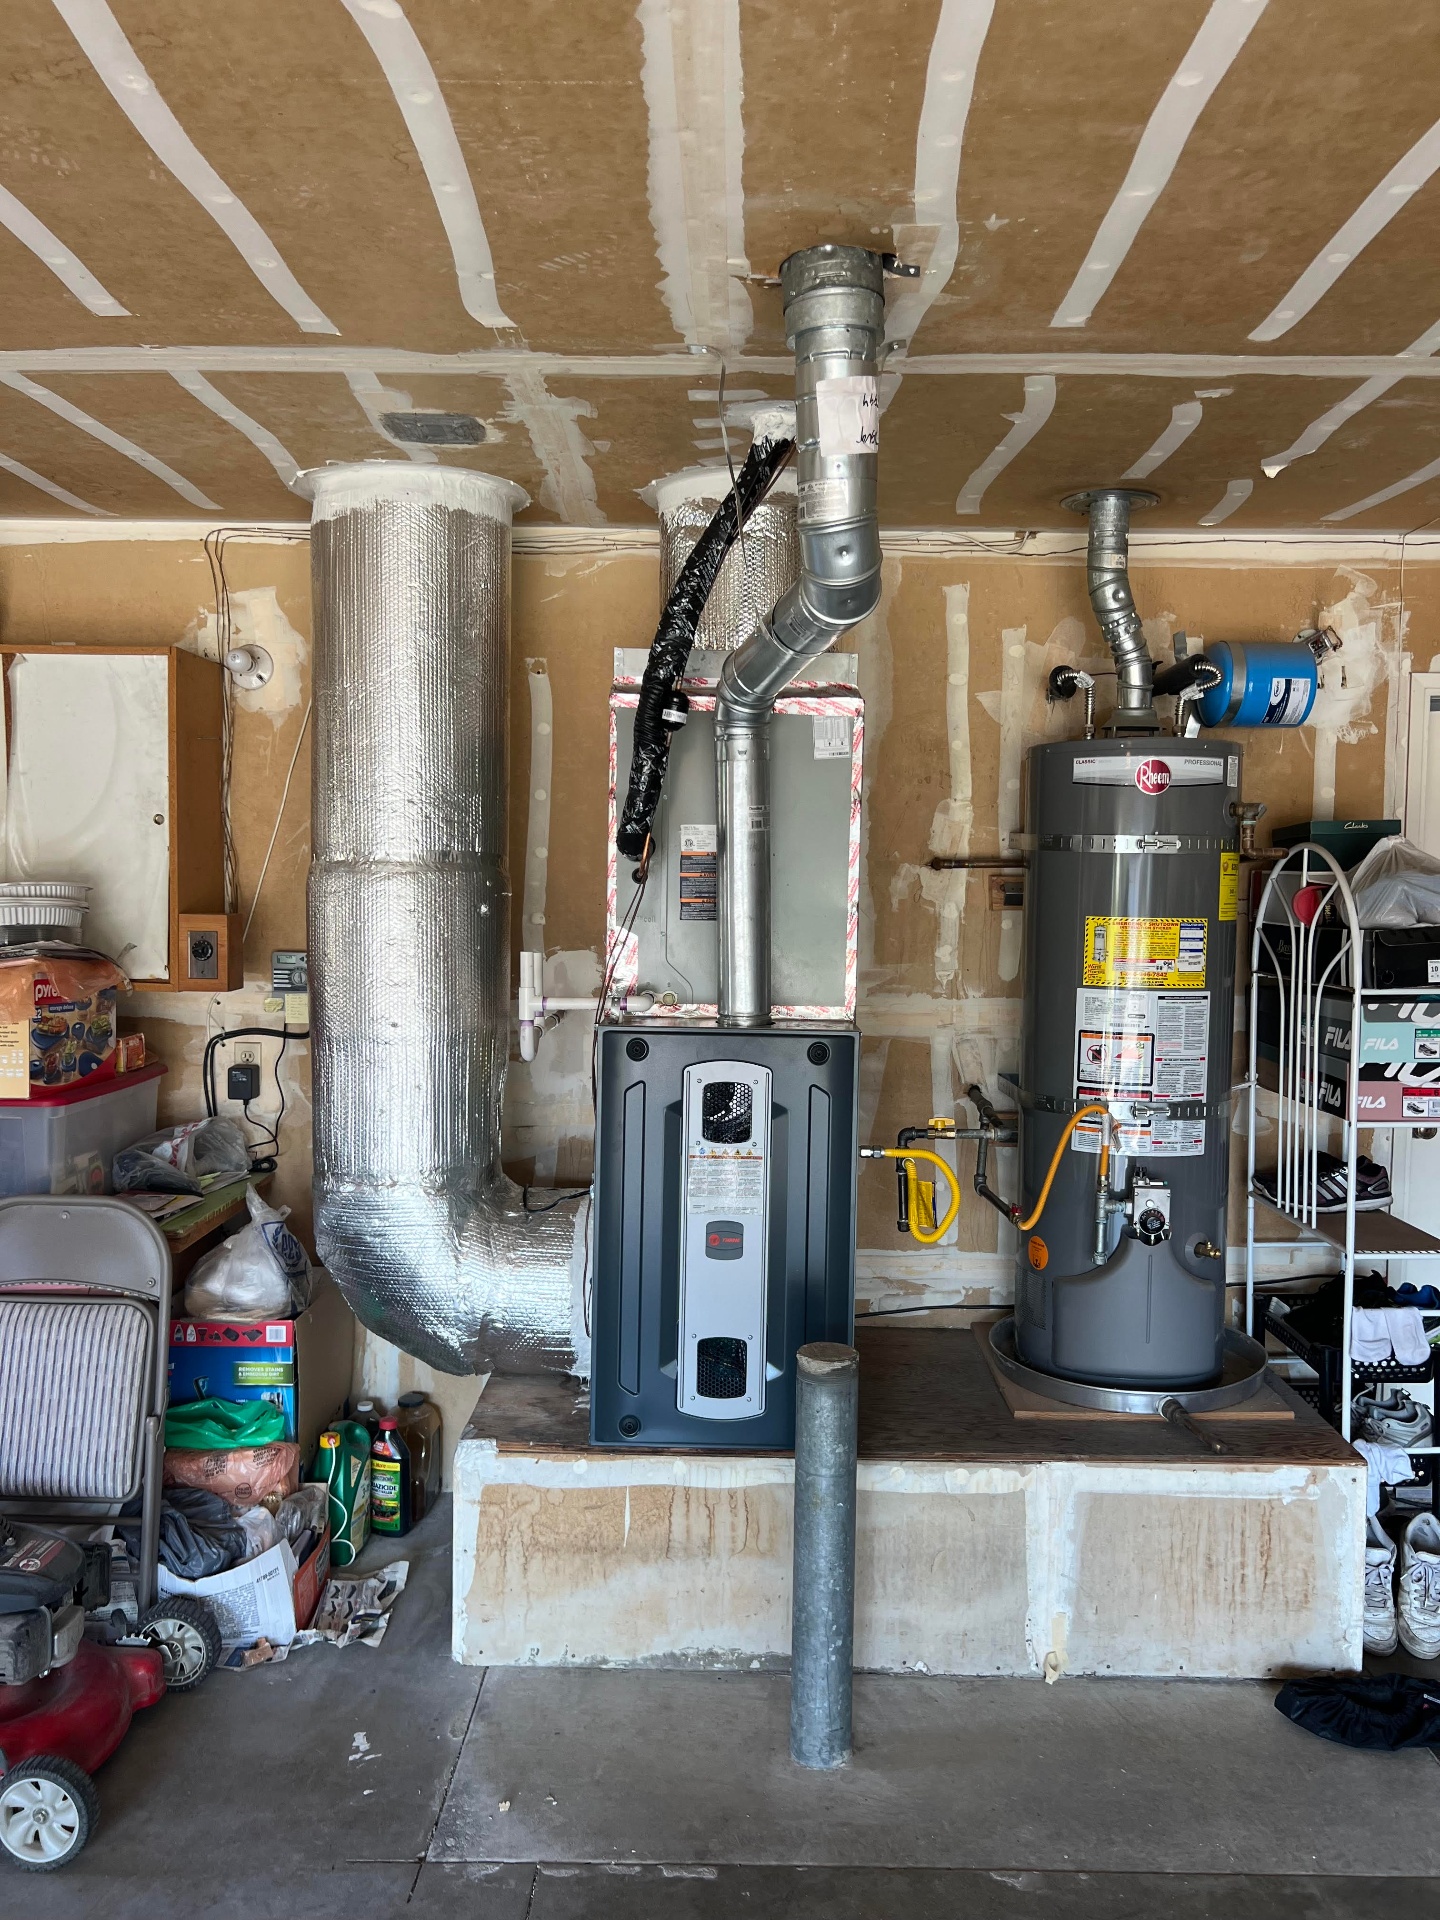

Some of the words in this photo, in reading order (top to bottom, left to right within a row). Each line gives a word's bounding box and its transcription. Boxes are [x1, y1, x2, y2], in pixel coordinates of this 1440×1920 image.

[1184, 759, 1223, 768] PROFESSIONAL
[1141, 759, 1170, 789] Rheem
[1344, 822, 1369, 830] Clarks
[1431, 965, 1439, 973] 10
[1364, 1038, 1399, 1051] FILA
[1319, 1081, 1341, 1108] FILA
